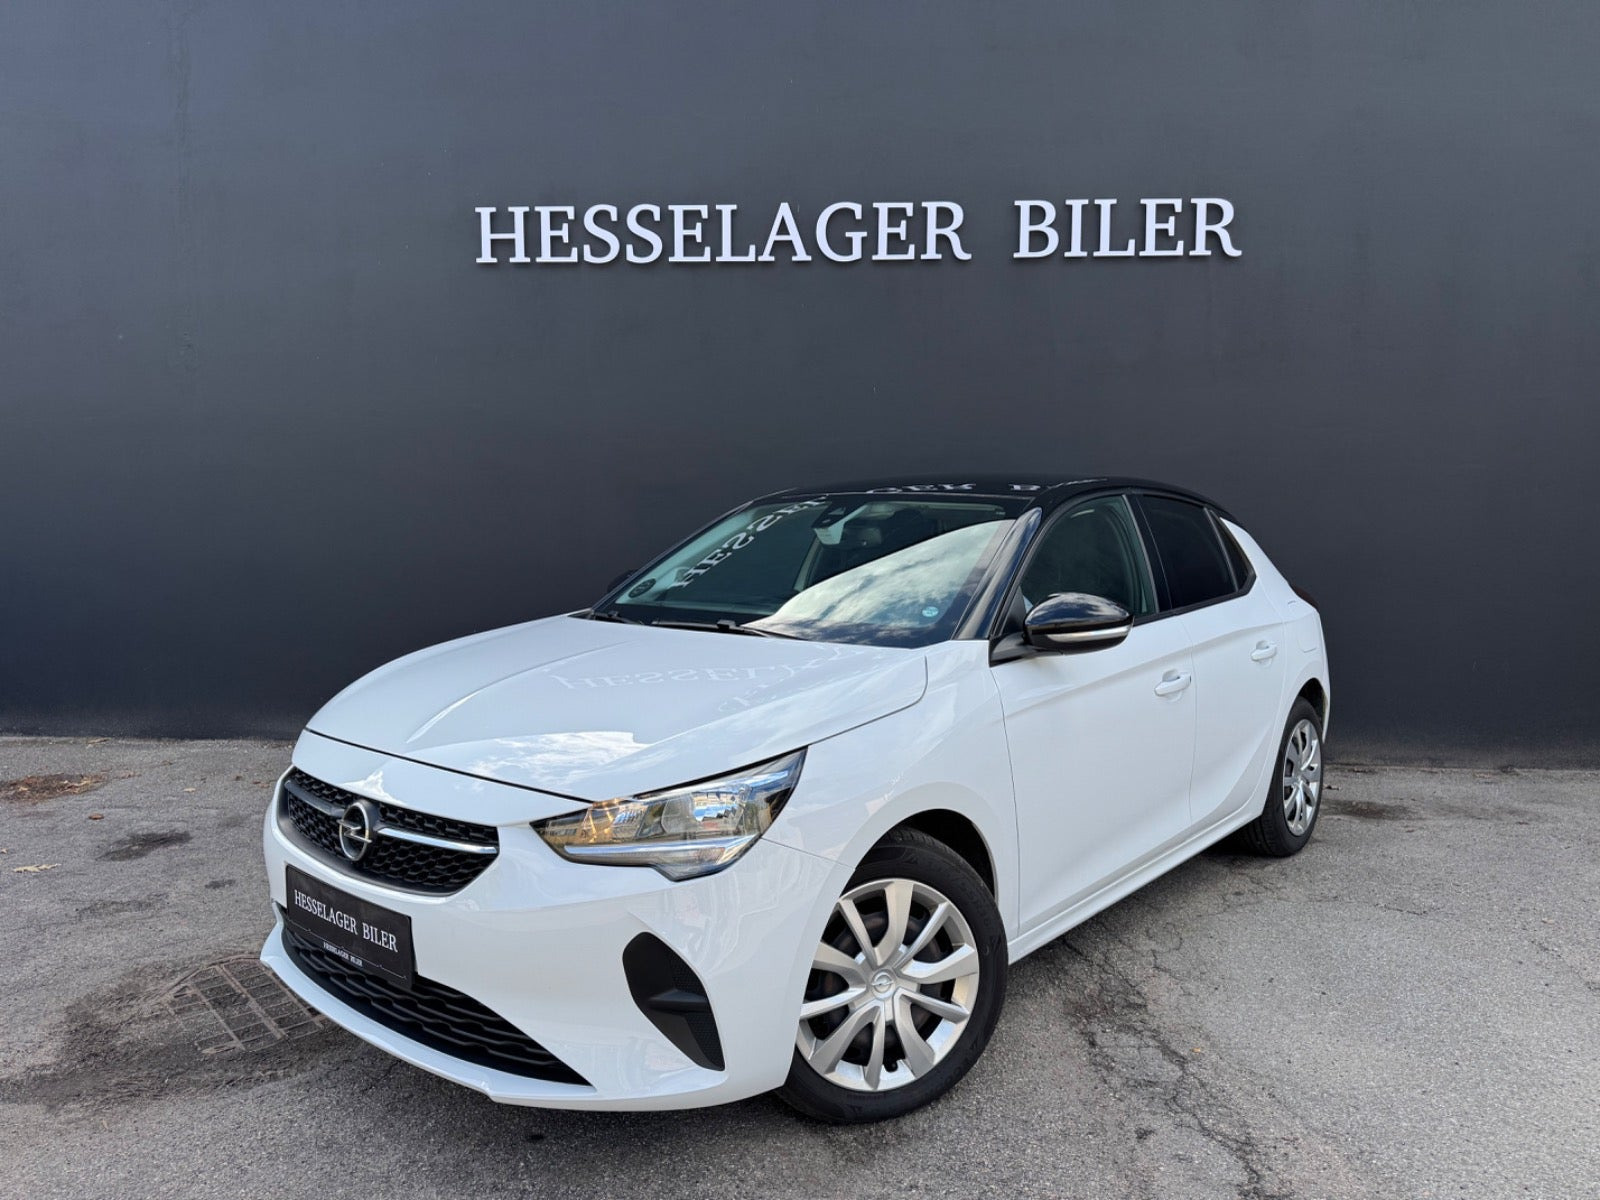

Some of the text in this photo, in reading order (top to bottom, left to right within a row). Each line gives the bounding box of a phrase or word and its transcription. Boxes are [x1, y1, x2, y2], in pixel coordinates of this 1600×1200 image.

[475, 197, 1243, 264] HESSELAGER BILER
[294, 890, 398, 952] HESSELAGER BILER
